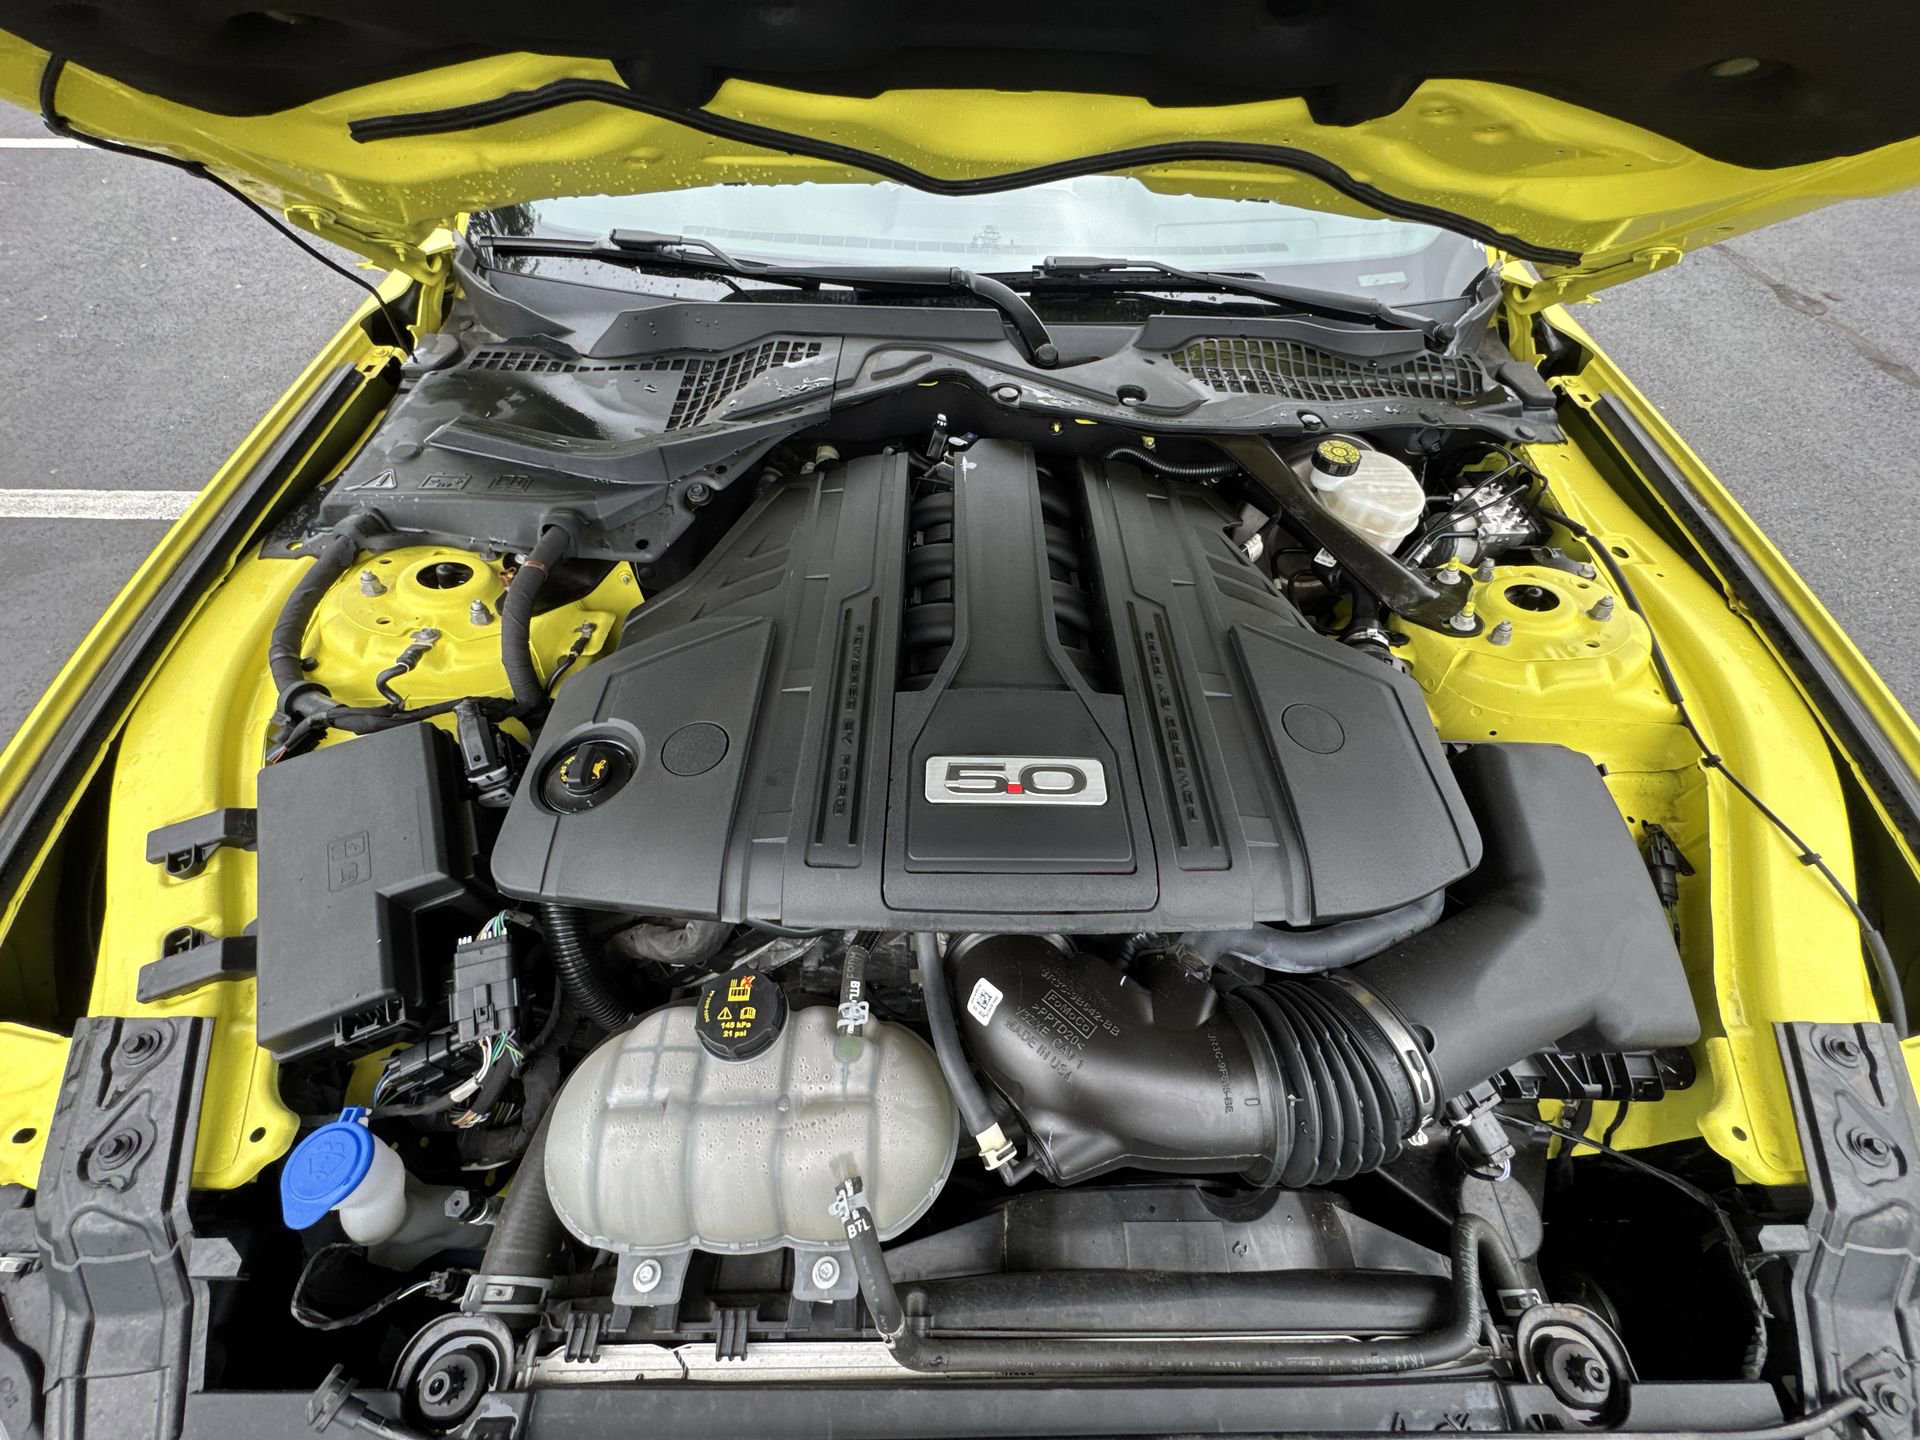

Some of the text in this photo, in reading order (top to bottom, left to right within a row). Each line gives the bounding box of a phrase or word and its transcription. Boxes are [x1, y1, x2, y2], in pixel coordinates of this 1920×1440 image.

[841, 718, 855, 745] BY
[1144, 631, 1198, 823] POWERED BY FORD
[832, 754, 852, 817] FORD
[944, 763, 1088, 797] 5.0
[849, 980, 861, 1000] BTL
[721, 1021, 751, 1029] 145 kPa
[1047, 993, 1090, 1032] FoMoCo
[723, 1030, 747, 1038] 21 psi
[1004, 1016, 1073, 1083] MADE IN USA
[847, 1218, 871, 1239] BTL
